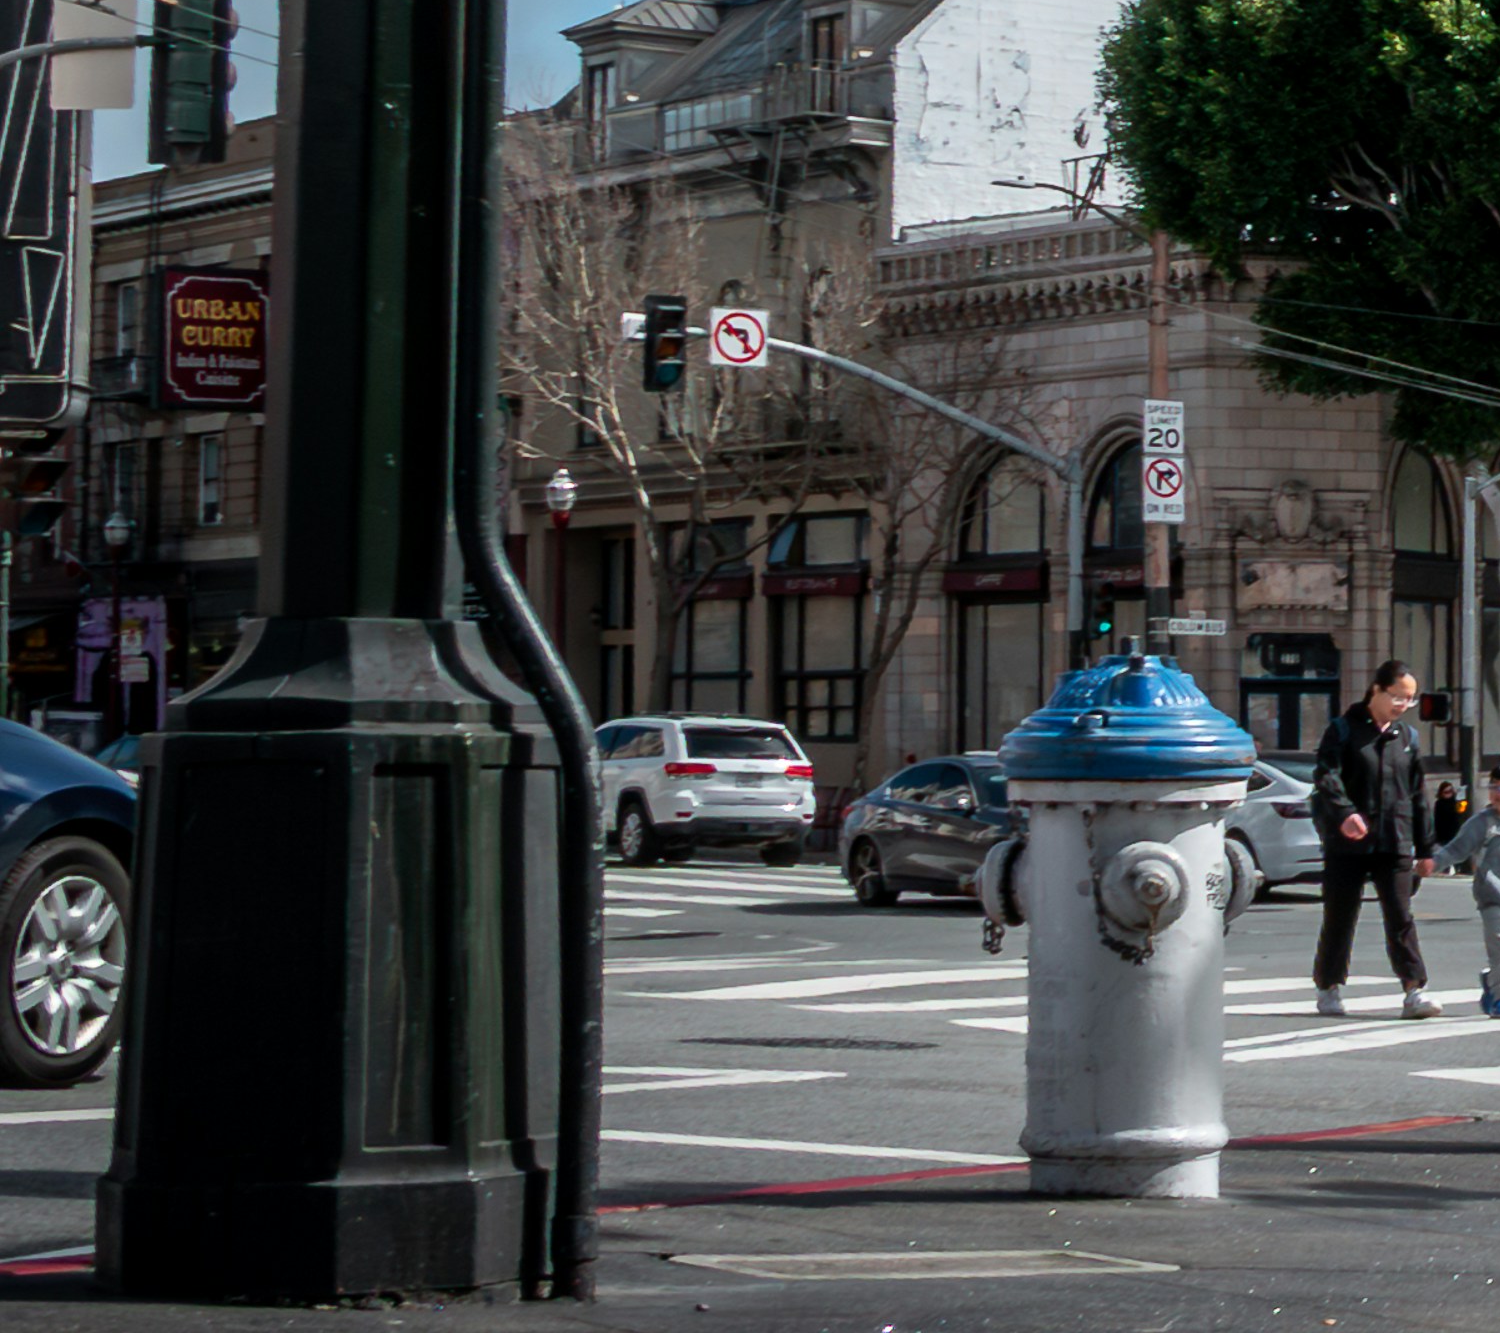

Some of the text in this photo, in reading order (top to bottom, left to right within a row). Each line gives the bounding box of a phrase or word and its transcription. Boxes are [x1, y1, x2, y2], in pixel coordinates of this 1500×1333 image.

[176, 298, 260, 321] URBAN
[182, 325, 255, 348] CURRY
[1148, 428, 1180, 448] 20
[1169, 620, 1225, 633] COLUMBUS
